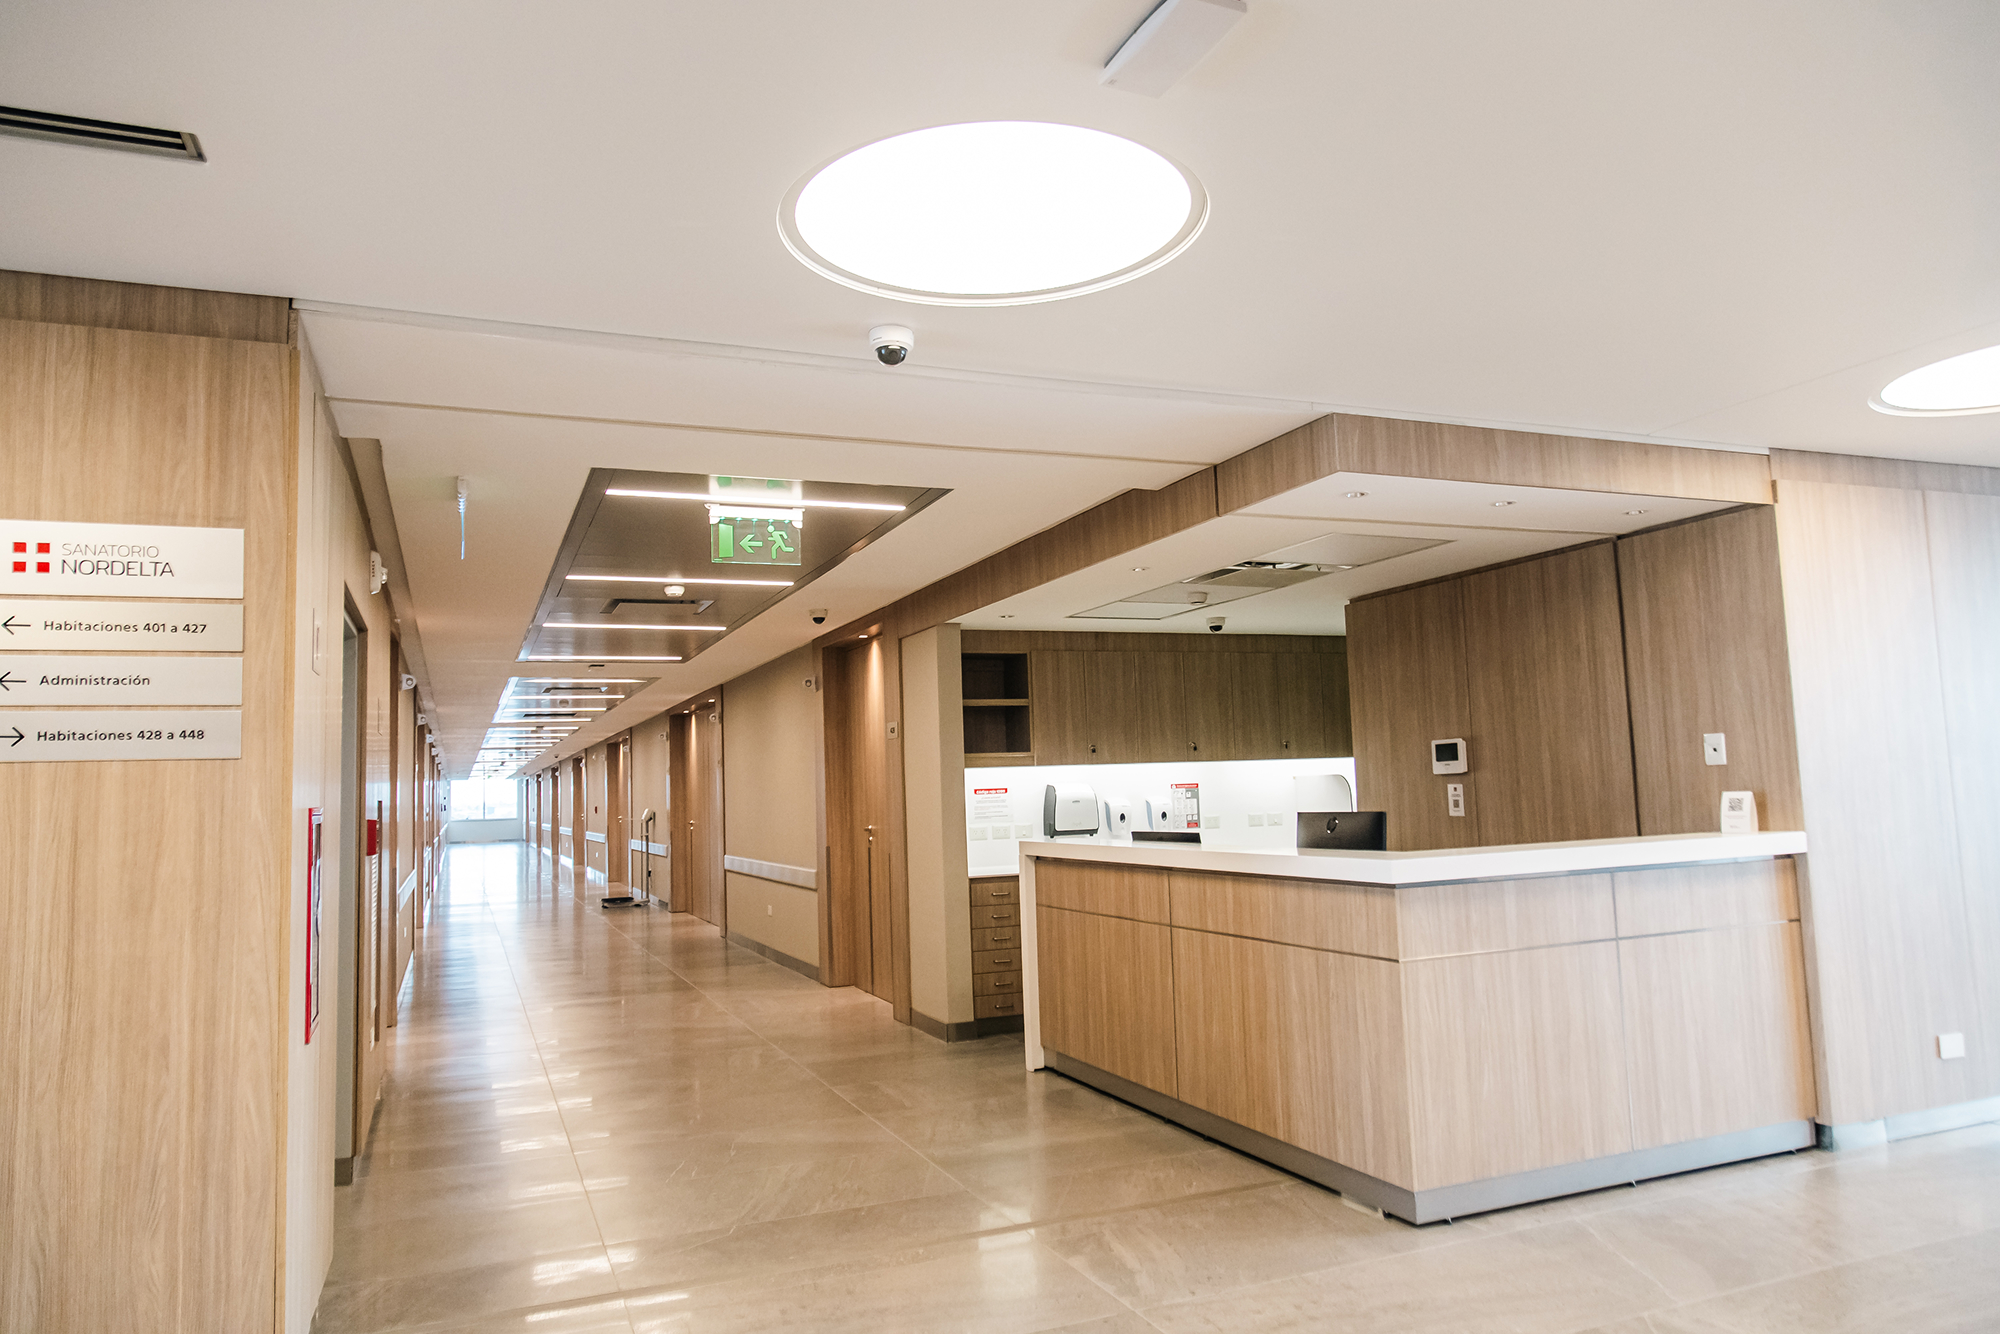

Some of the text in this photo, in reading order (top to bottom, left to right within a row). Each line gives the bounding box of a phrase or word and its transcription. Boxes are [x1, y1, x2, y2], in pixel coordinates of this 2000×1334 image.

[61, 543, 160, 559] SANATORIO
[61, 559, 175, 577] NORDELTA
[43, 620, 207, 634] Habitaciones 401 a 427
[39, 674, 151, 686] Administración
[37, 729, 205, 742] Habitaciones 428 a 448
